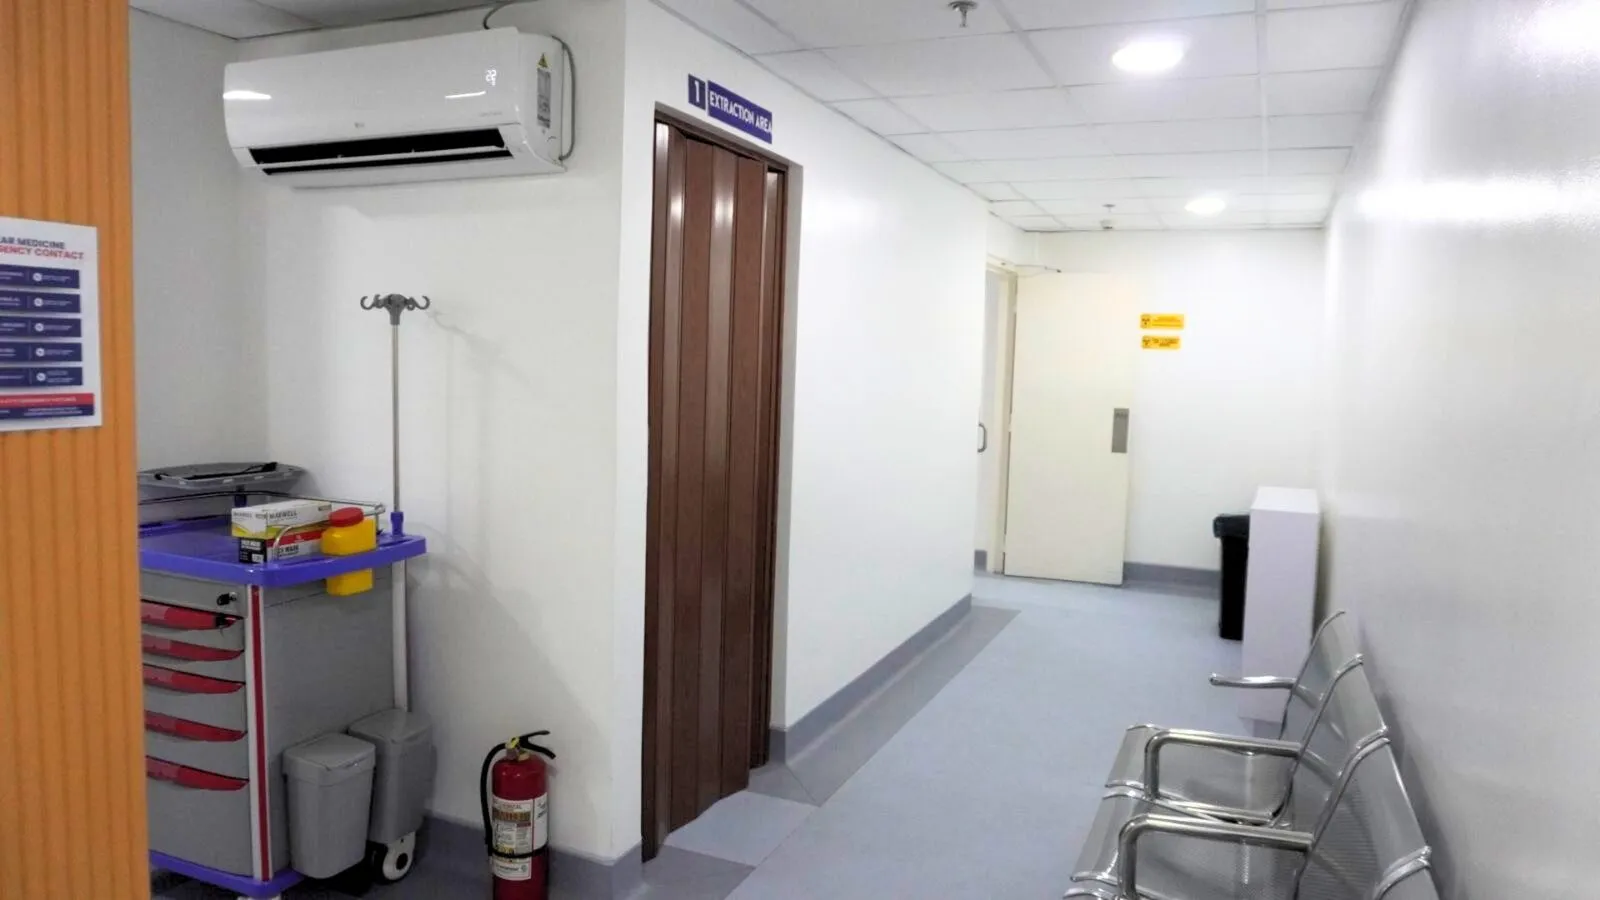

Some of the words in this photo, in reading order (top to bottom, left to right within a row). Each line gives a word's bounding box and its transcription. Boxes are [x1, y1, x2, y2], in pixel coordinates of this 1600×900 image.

[694, 80, 700, 103] 1
[709, 91, 754, 126] EXTRACTION
[755, 115, 772, 133] AREA
[17, 238, 65, 249] MEDICINE
[34, 248, 84, 259] CONTACT
